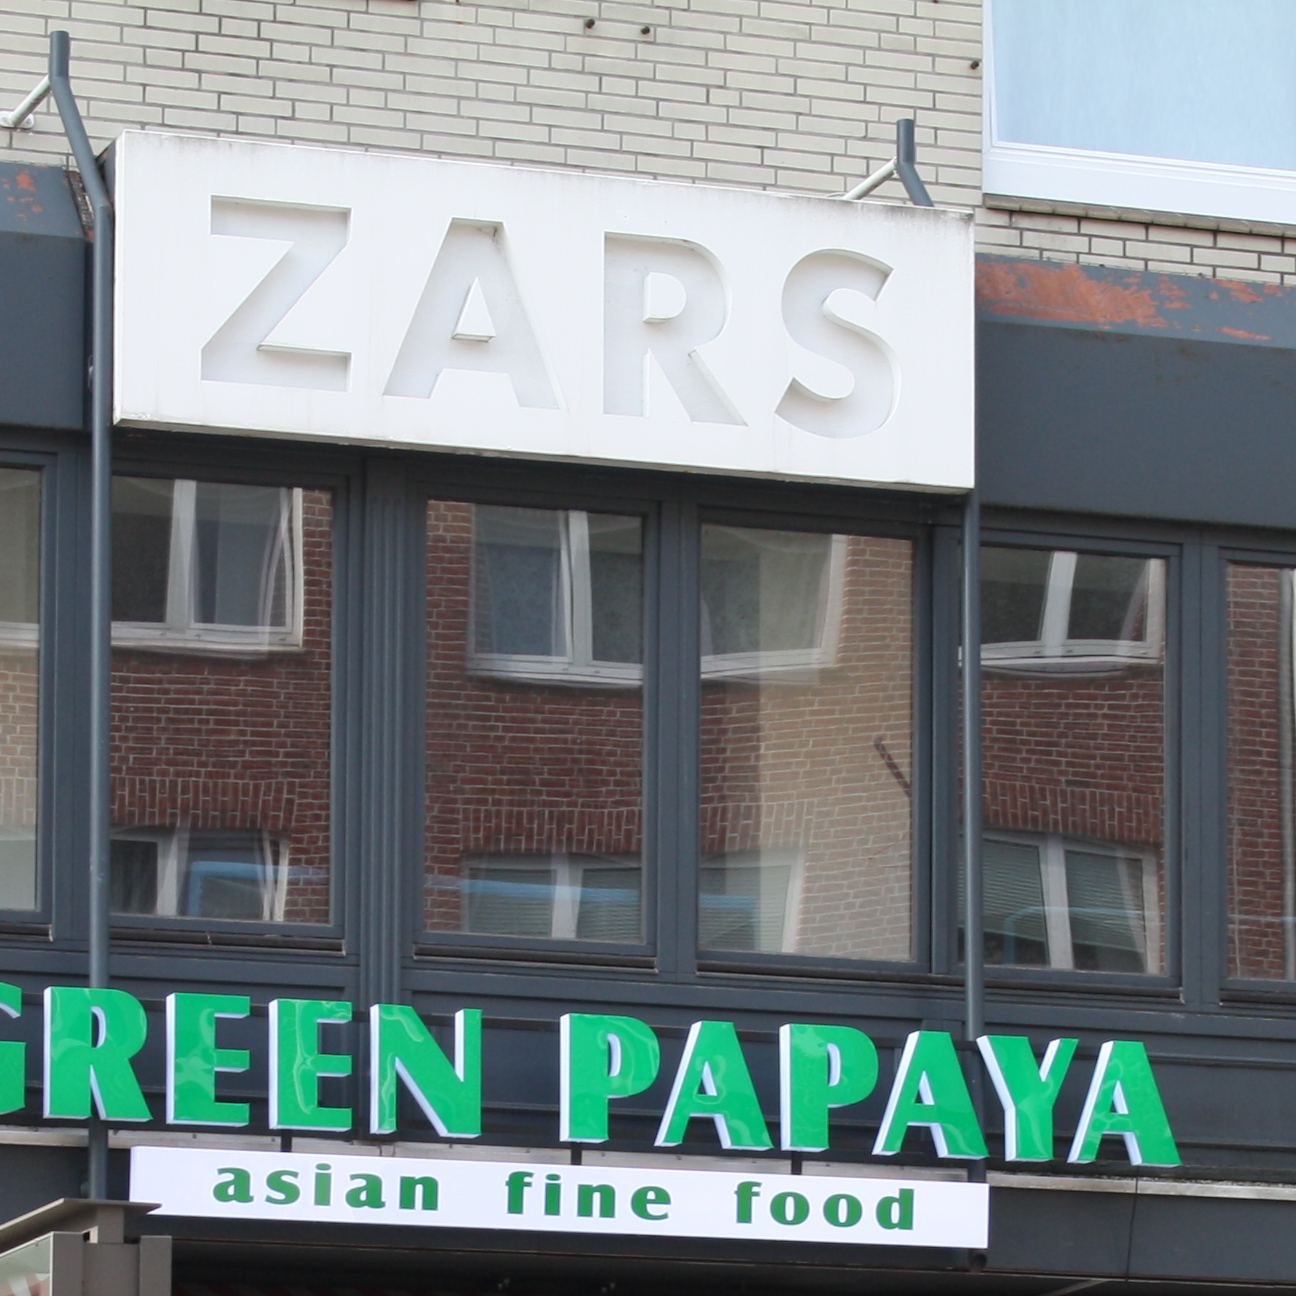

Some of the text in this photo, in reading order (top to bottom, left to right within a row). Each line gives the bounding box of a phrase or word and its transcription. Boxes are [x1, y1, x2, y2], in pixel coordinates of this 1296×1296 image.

[201, 195, 903, 440] ZARS
[559, 1013, 1182, 1167] PAPAYA
[212, 1163, 914, 1231] asian fine food
